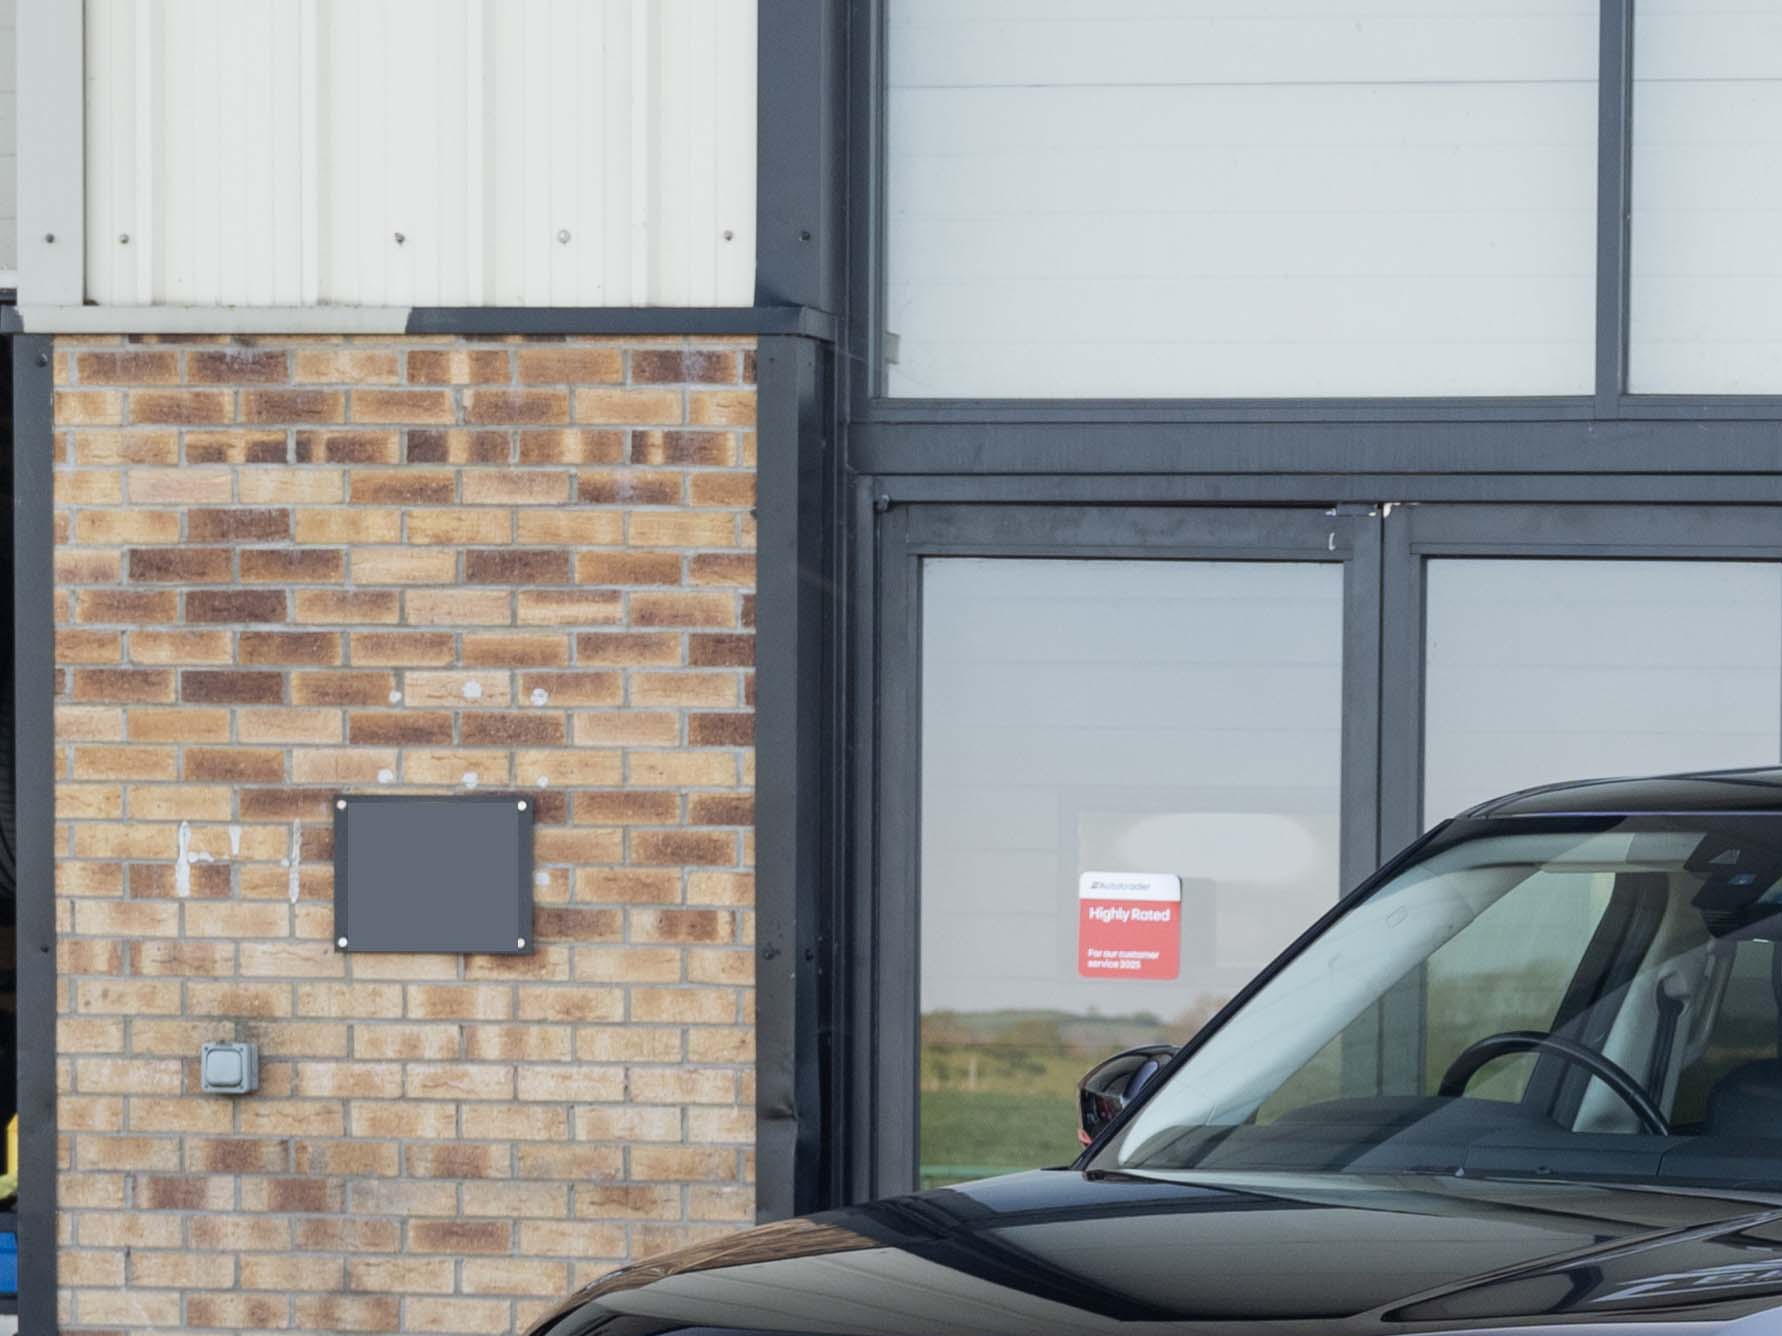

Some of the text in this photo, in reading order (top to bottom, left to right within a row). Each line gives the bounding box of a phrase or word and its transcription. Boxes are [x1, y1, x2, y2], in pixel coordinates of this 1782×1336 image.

[1088, 907, 1171, 922] Highly Rated
[1087, 949, 1102, 957] For
